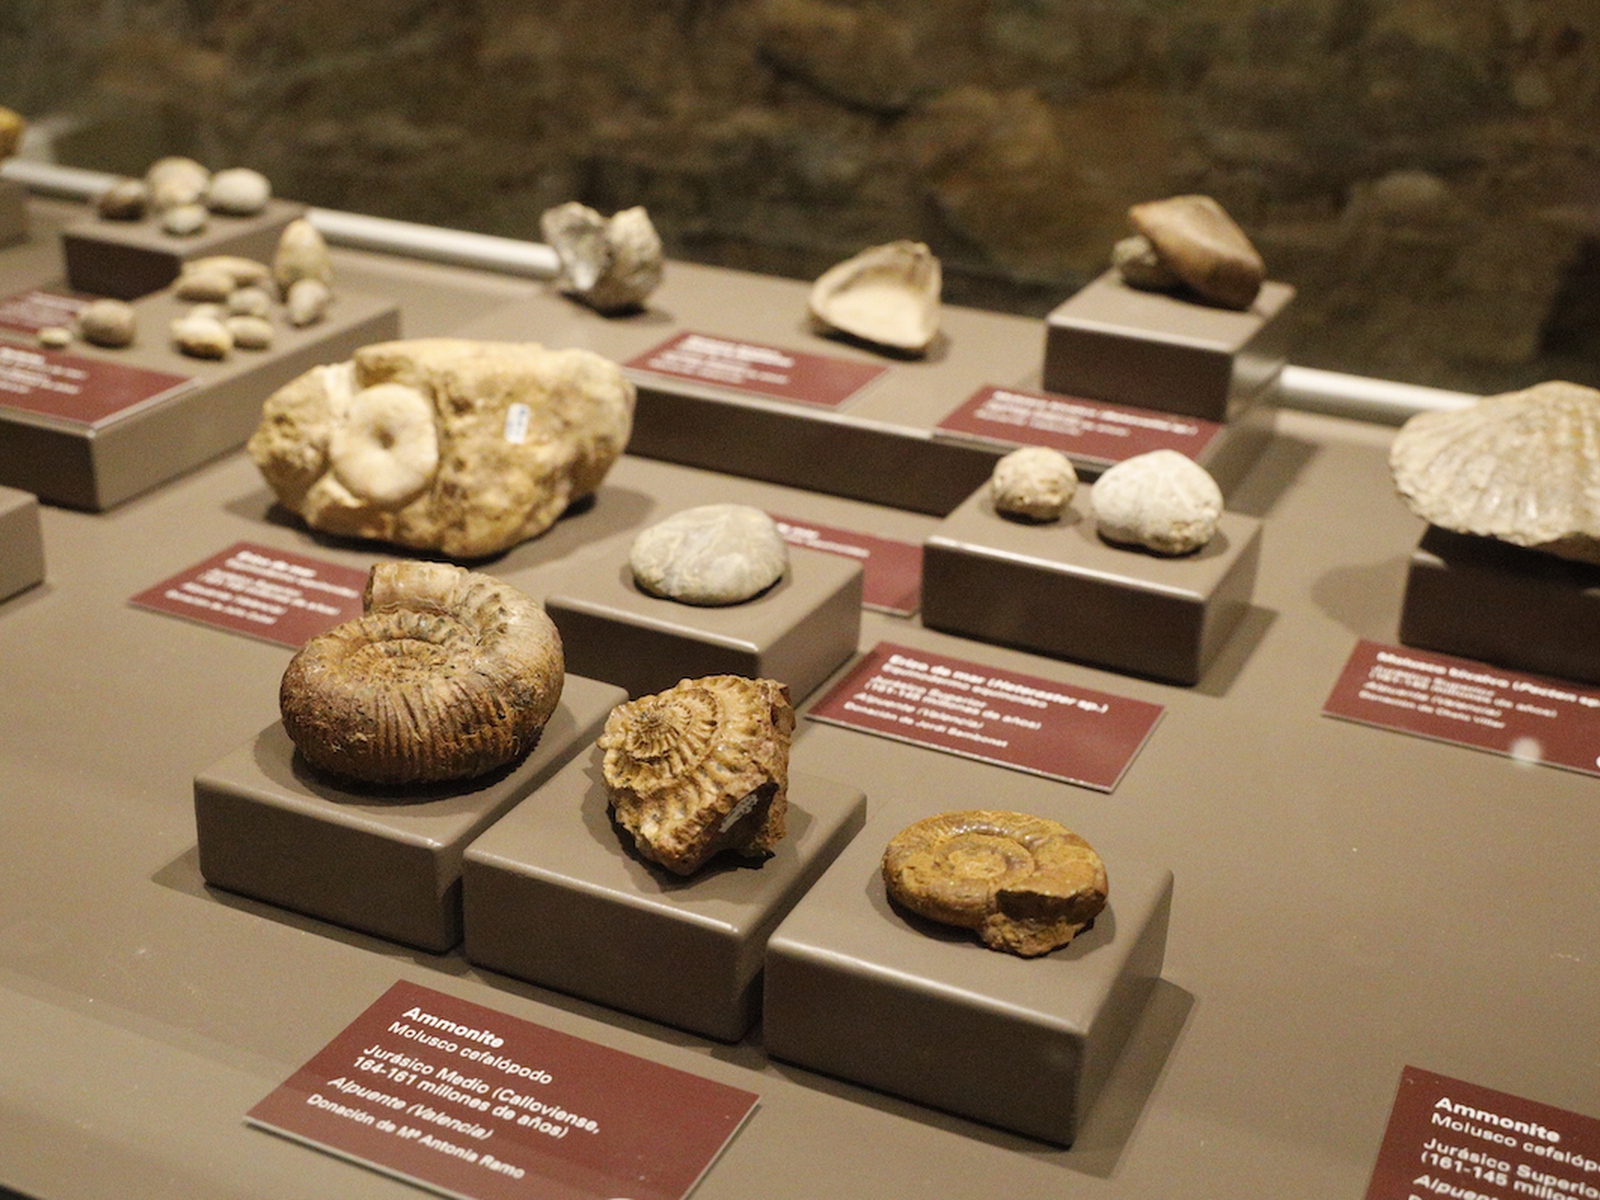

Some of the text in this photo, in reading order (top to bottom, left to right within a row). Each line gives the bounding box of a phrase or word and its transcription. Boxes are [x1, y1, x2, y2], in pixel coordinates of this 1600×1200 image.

[388, 1021, 553, 1085] Molusco cefalópodo
[401, 1006, 505, 1049] Ammonite
[327, 1076, 494, 1141] Alpuente (Valencia)
[353, 1056, 569, 1139] 164-161 millones de años)
[363, 1044, 601, 1134] Jurásico Medio (Calloviense,
[1435, 1097, 1561, 1143] Ammonite
[306, 1093, 375, 1125] Donación
[375, 1118, 397, 1133] de
[418, 1134, 478, 1163] Antonia
[478, 1154, 526, 1179] Ramo
[1431, 1113, 1600, 1172] Molusco cefalóp
[1420, 1151, 1508, 1187] (161-145
[1423, 1138, 1600, 1199] Jurásico Superio
